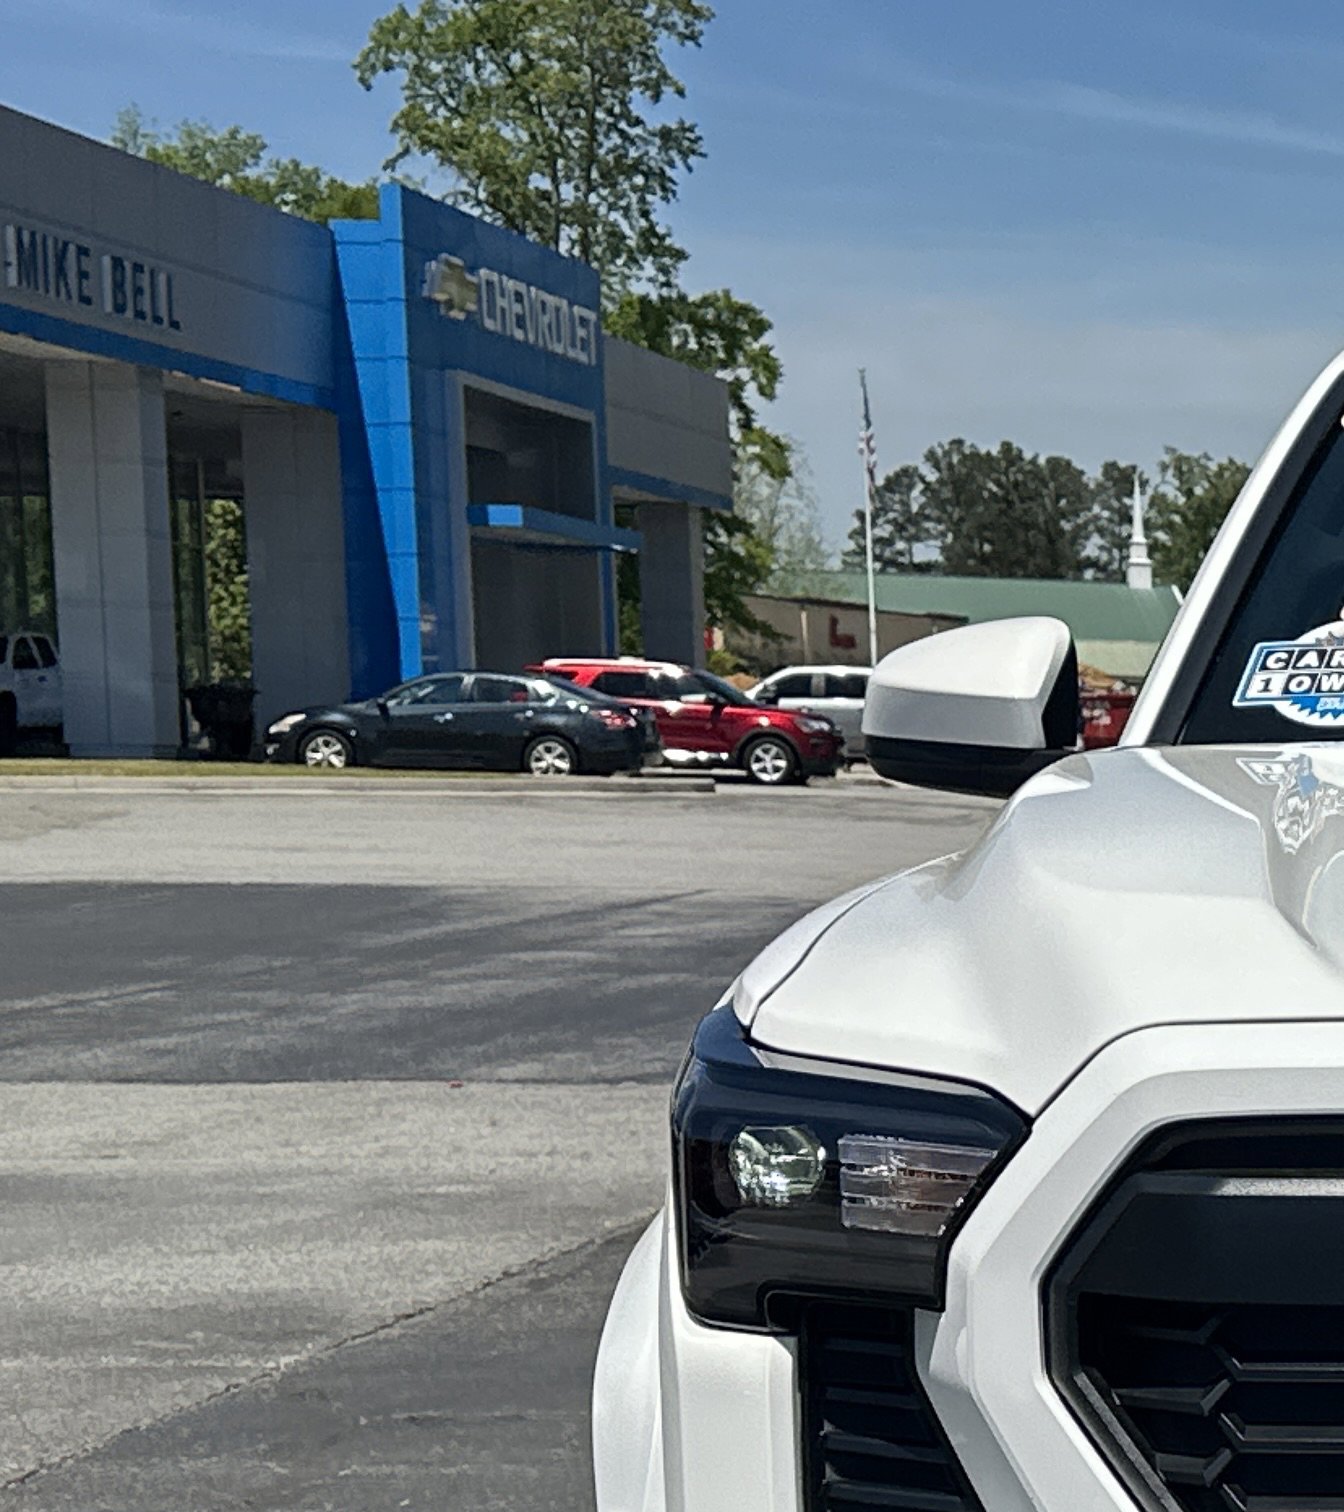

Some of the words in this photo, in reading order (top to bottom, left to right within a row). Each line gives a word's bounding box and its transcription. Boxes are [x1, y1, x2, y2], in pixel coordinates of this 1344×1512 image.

[5, 224, 93, 306] MIKE
[101, 254, 182, 331] BELL
[479, 267, 598, 366] CHEVROLET
[1256, 676, 1273, 693] 1
